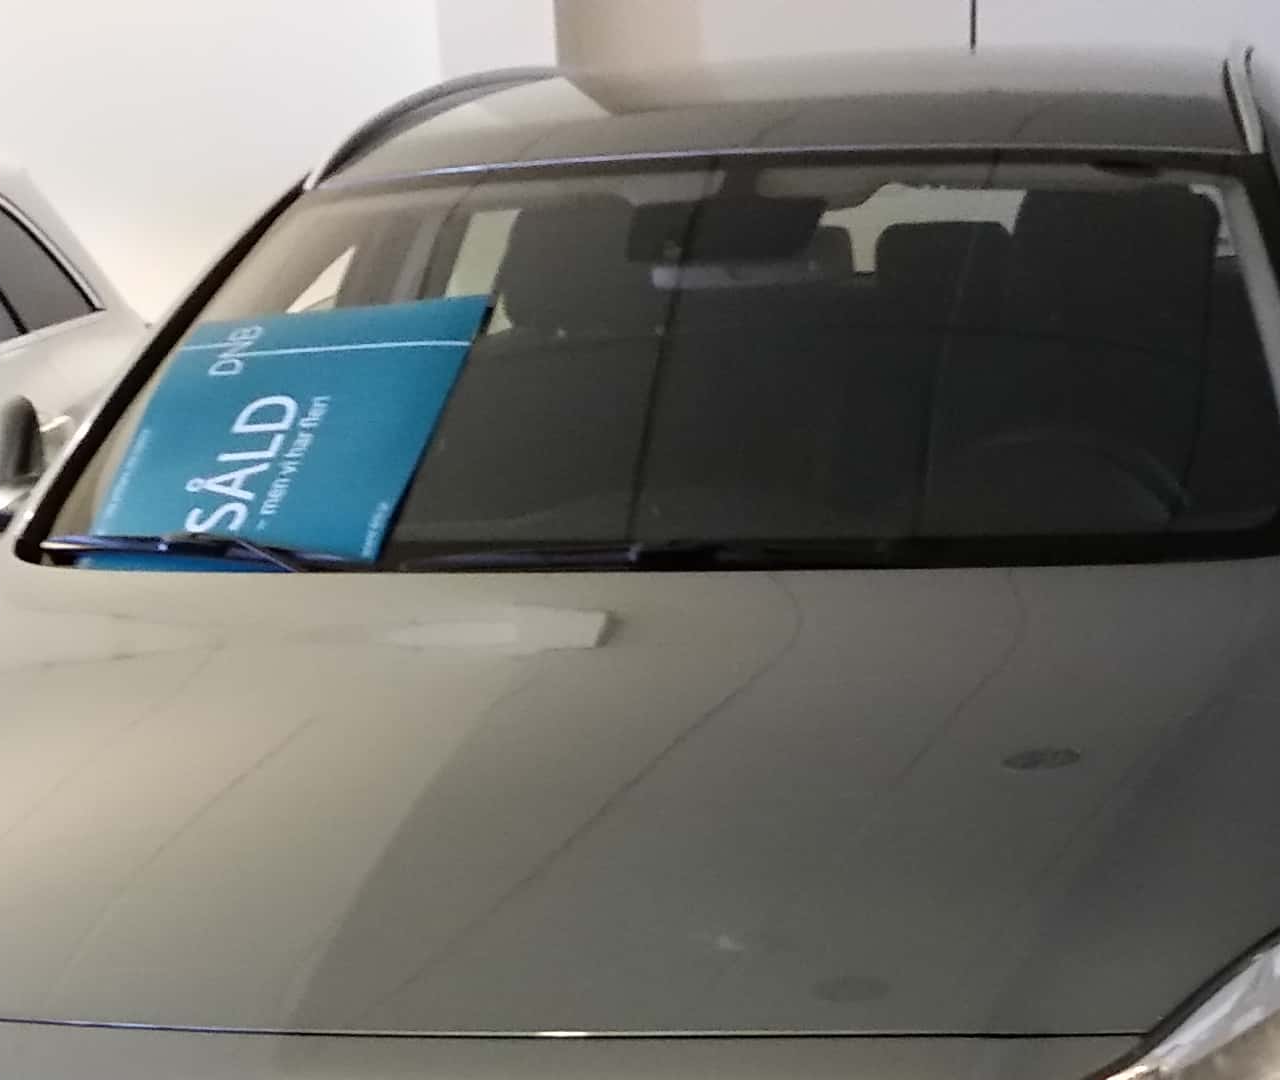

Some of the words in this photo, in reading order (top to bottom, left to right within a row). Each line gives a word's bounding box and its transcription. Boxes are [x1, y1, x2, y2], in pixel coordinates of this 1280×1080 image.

[208, 324, 264, 376] DNB
[283, 431, 315, 459] har
[184, 395, 299, 533] SÅLD
[279, 460, 300, 477] vi
[260, 478, 291, 515] men
